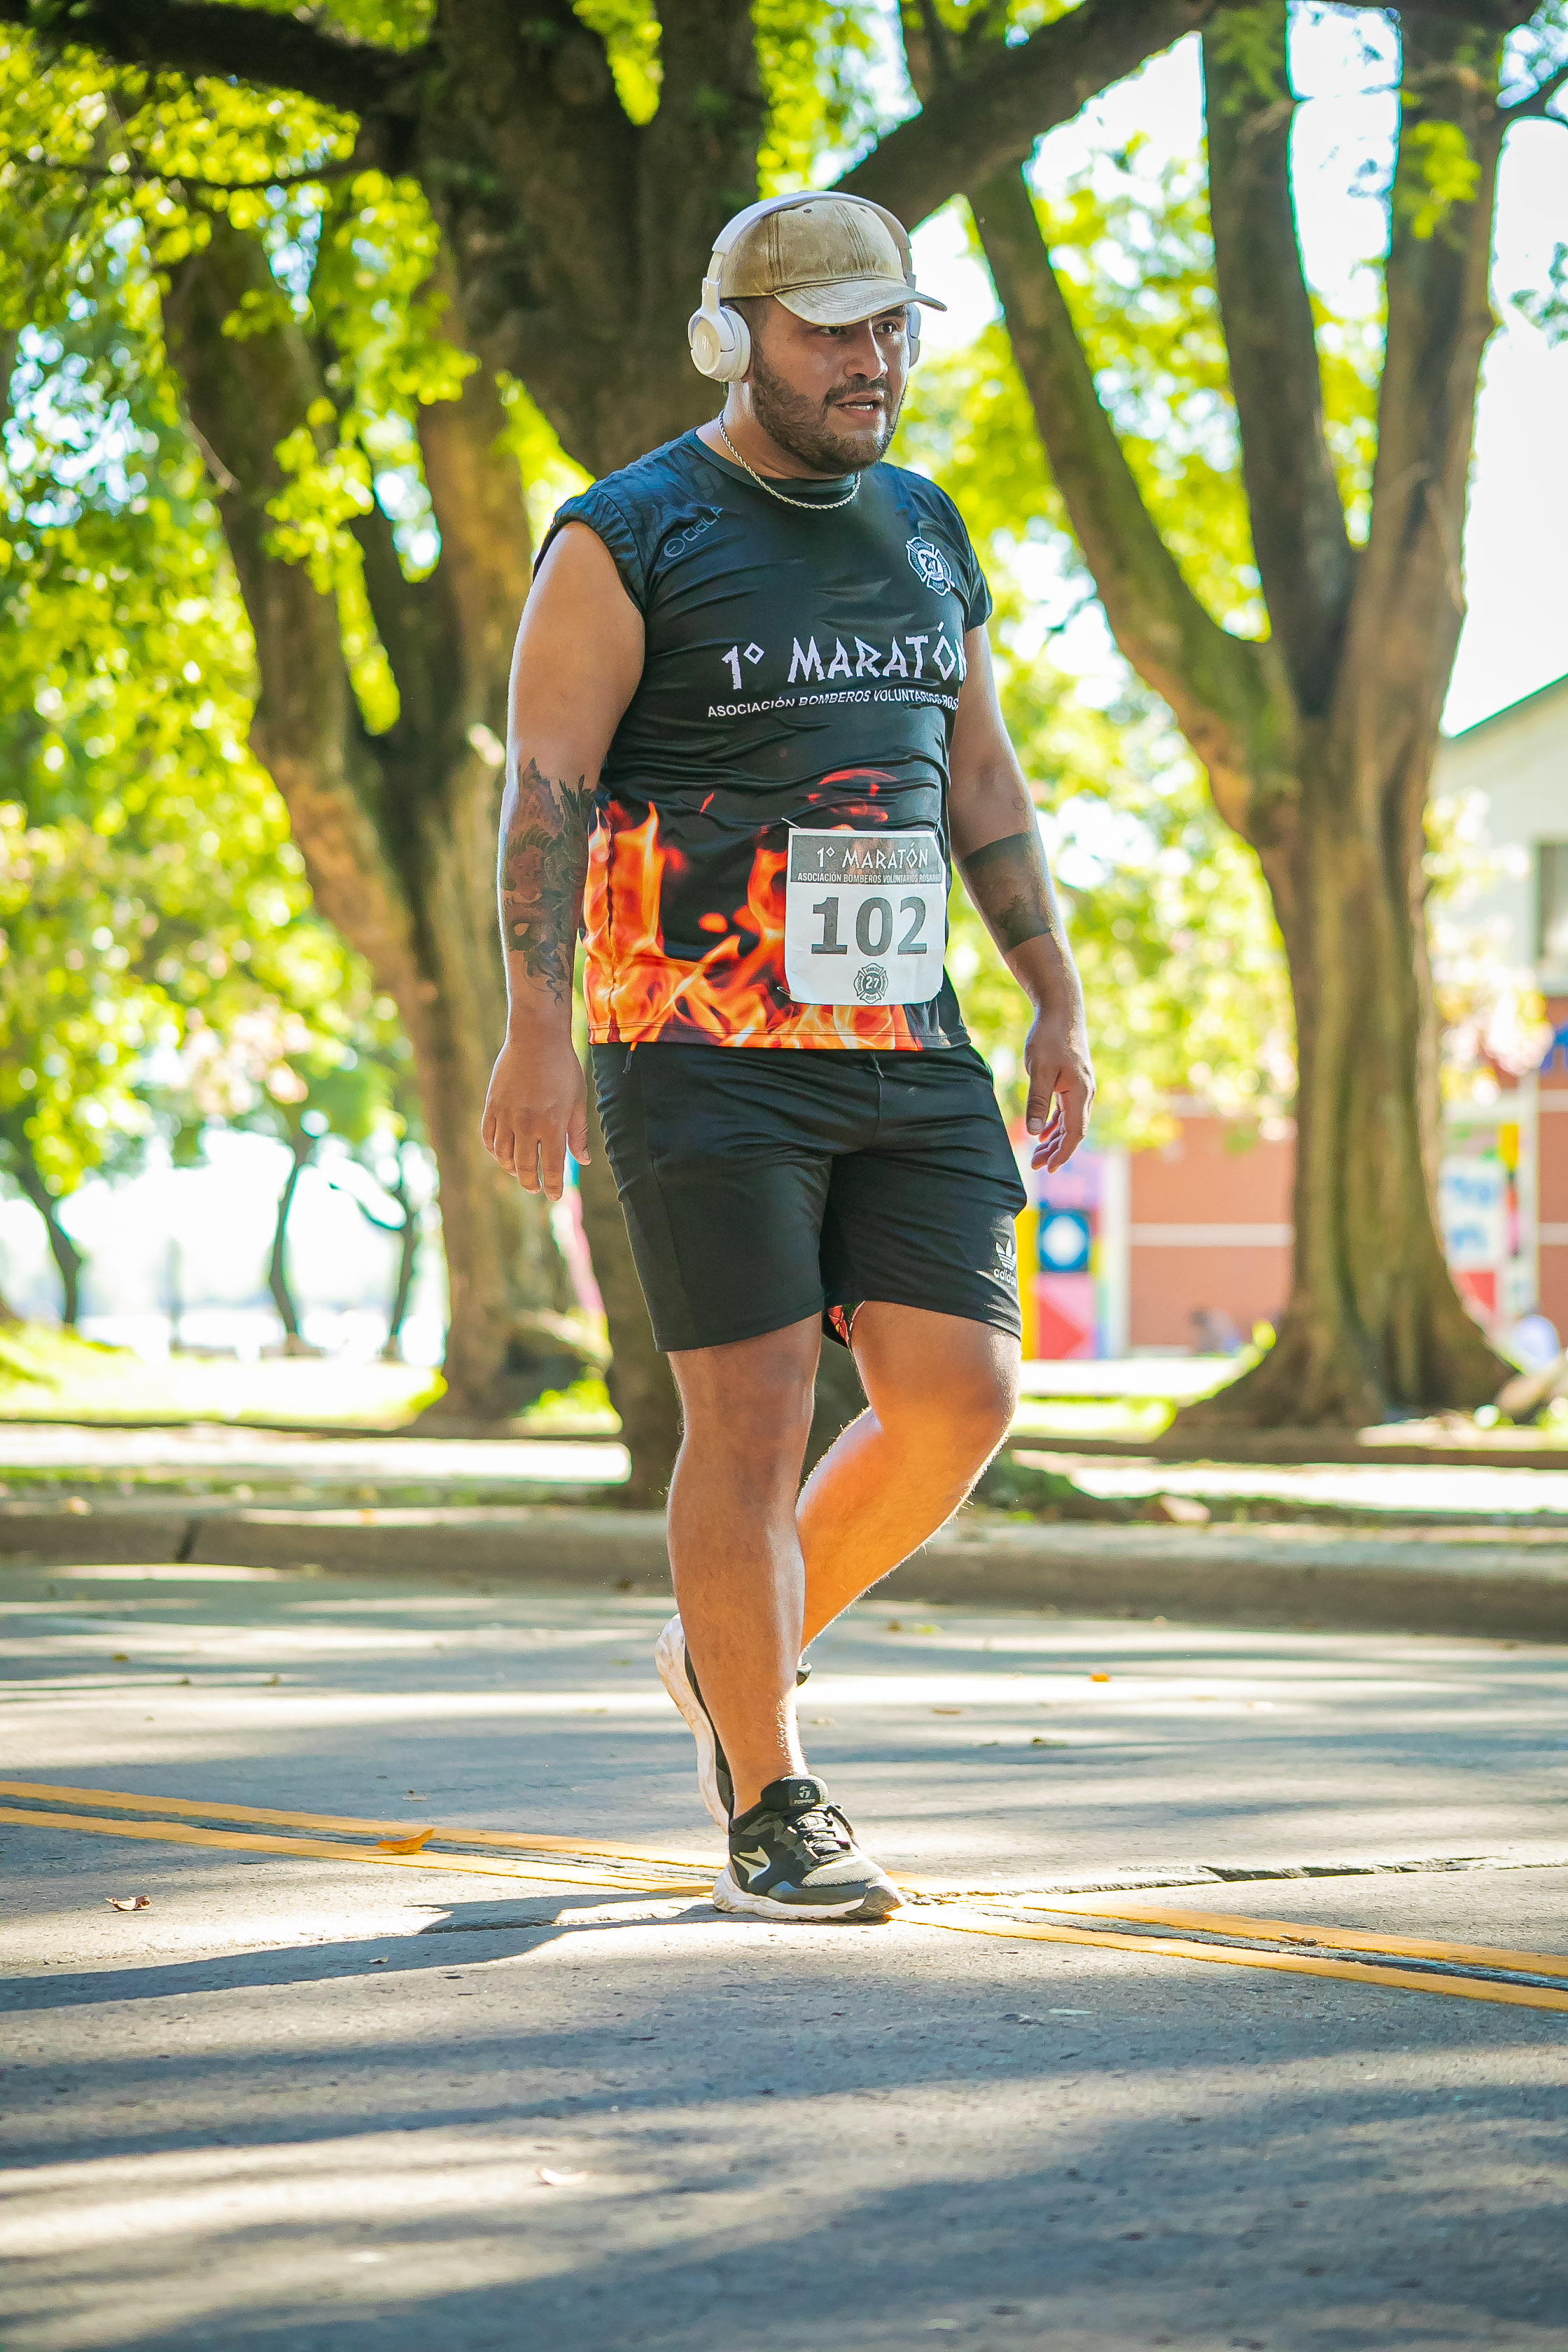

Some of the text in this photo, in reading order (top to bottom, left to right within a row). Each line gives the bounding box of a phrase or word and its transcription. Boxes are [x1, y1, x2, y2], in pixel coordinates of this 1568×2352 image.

[722, 621, 967, 690] 1° MARATÓN
[708, 696, 794, 718] ASOCIACIÓN
[799, 689, 871, 707] BOMBEROS
[874, 688, 942, 705] VOLUNTARIOS
[816, 842, 929, 869] 1° MARATÓN
[797, 871, 941, 883] ASOCIACIÓN BOMBEROS VOLUNTARIOS ROSARIO
[811, 896, 927, 957] 102
[865, 975, 881, 990] 27
[993, 1268, 1017, 1287] adidas
